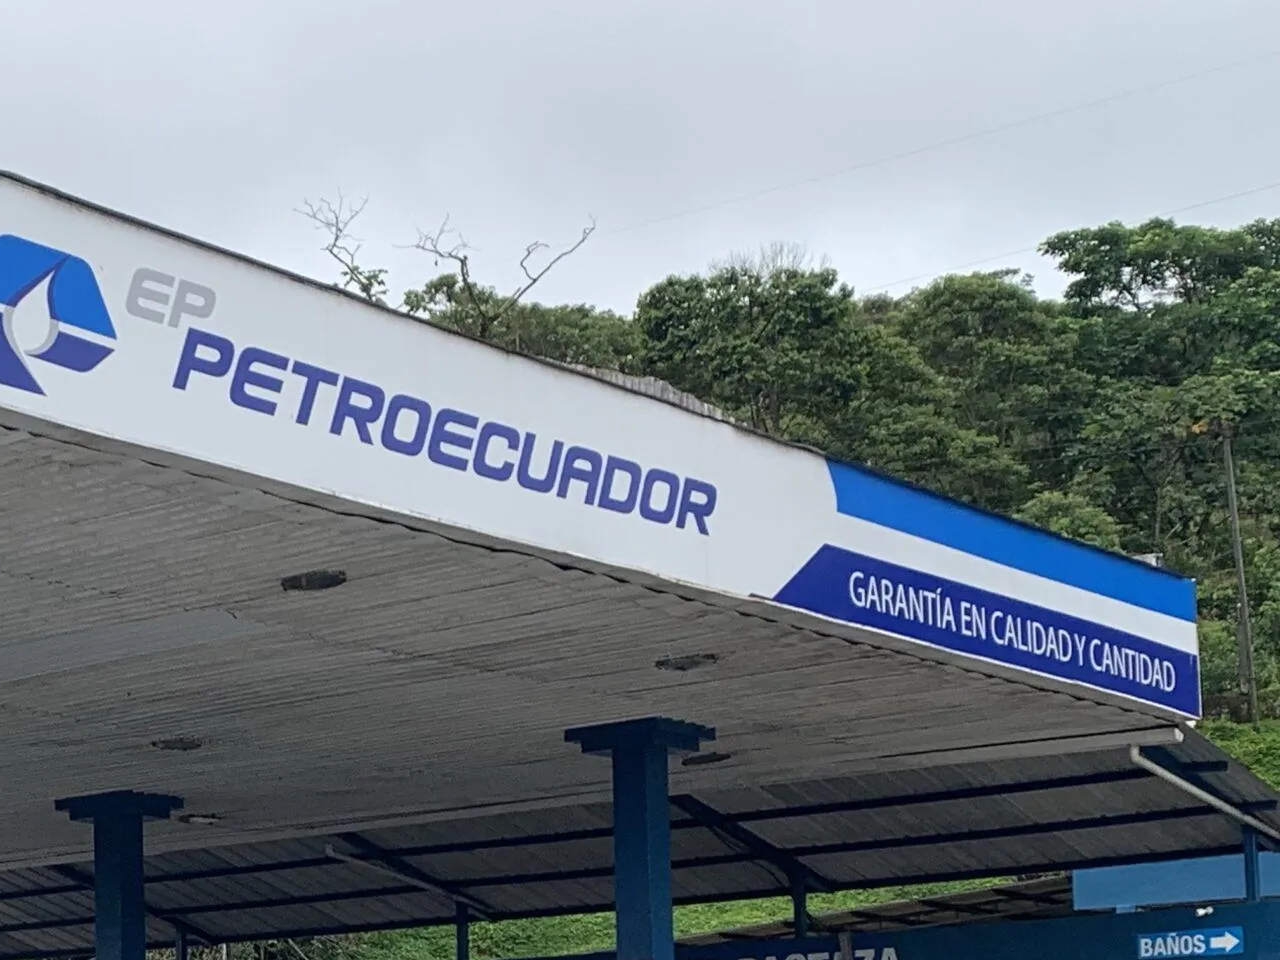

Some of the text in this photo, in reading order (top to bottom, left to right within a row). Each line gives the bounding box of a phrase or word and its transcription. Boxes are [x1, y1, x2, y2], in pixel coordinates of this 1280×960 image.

[124, 266, 218, 329] EP
[172, 327, 718, 536] PETROECUADOR
[848, 570, 1176, 693] GARANTÍA EN CALIDAD Y CANTIDAD
[1140, 932, 1207, 957] BAÑOS
